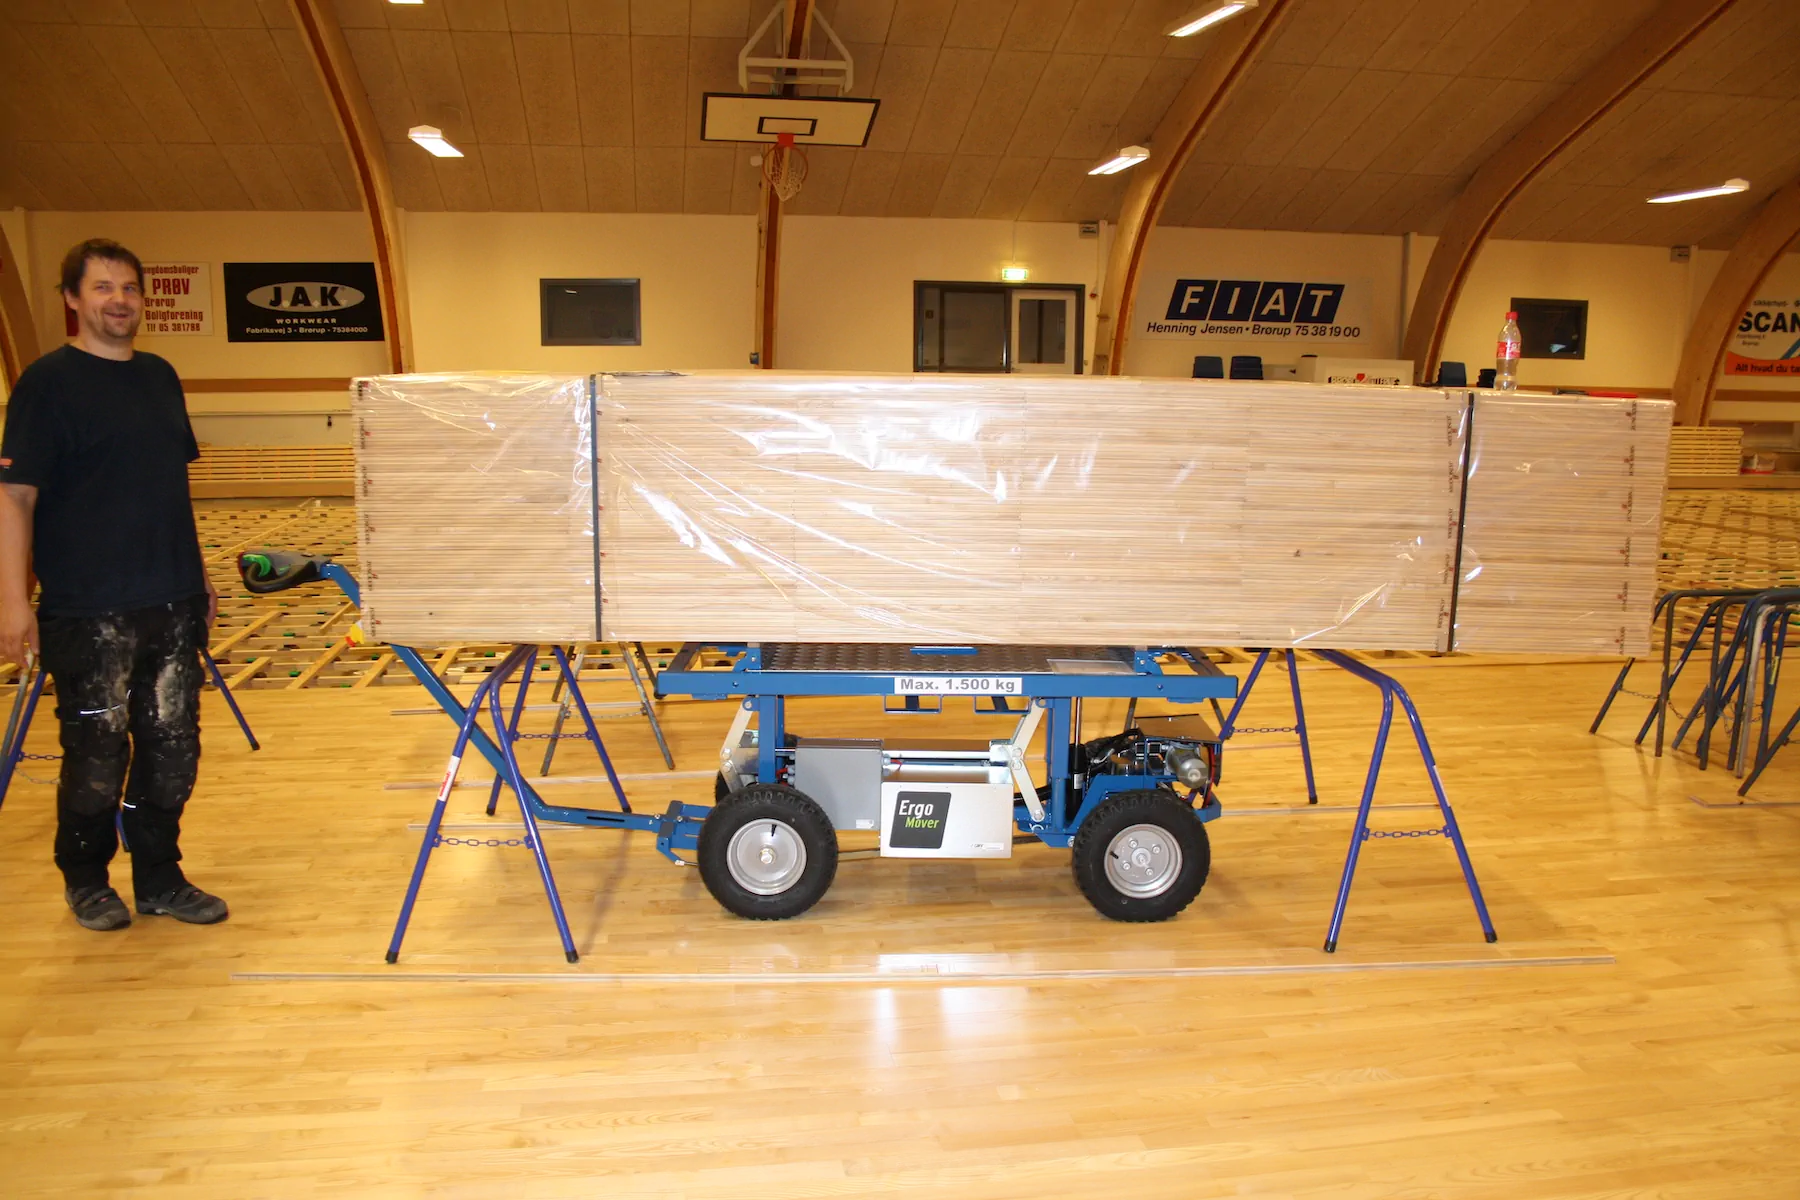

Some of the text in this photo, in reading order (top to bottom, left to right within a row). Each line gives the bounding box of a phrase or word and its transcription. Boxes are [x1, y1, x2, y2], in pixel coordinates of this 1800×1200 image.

[152, 278, 190, 295] PRØV
[1179, 285, 1334, 317] FIAT
[145, 310, 204, 321] Boligforening
[246, 327, 286, 335] Fabriksvej
[1146, 322, 1197, 336] Henning
[1200, 324, 1243, 335] Jensen
[1252, 324, 1291, 337] Brørup
[900, 678, 1015, 693] Max. 1.500 kg
[899, 800, 934, 819] Ergo
[905, 816, 940, 829] Mover
